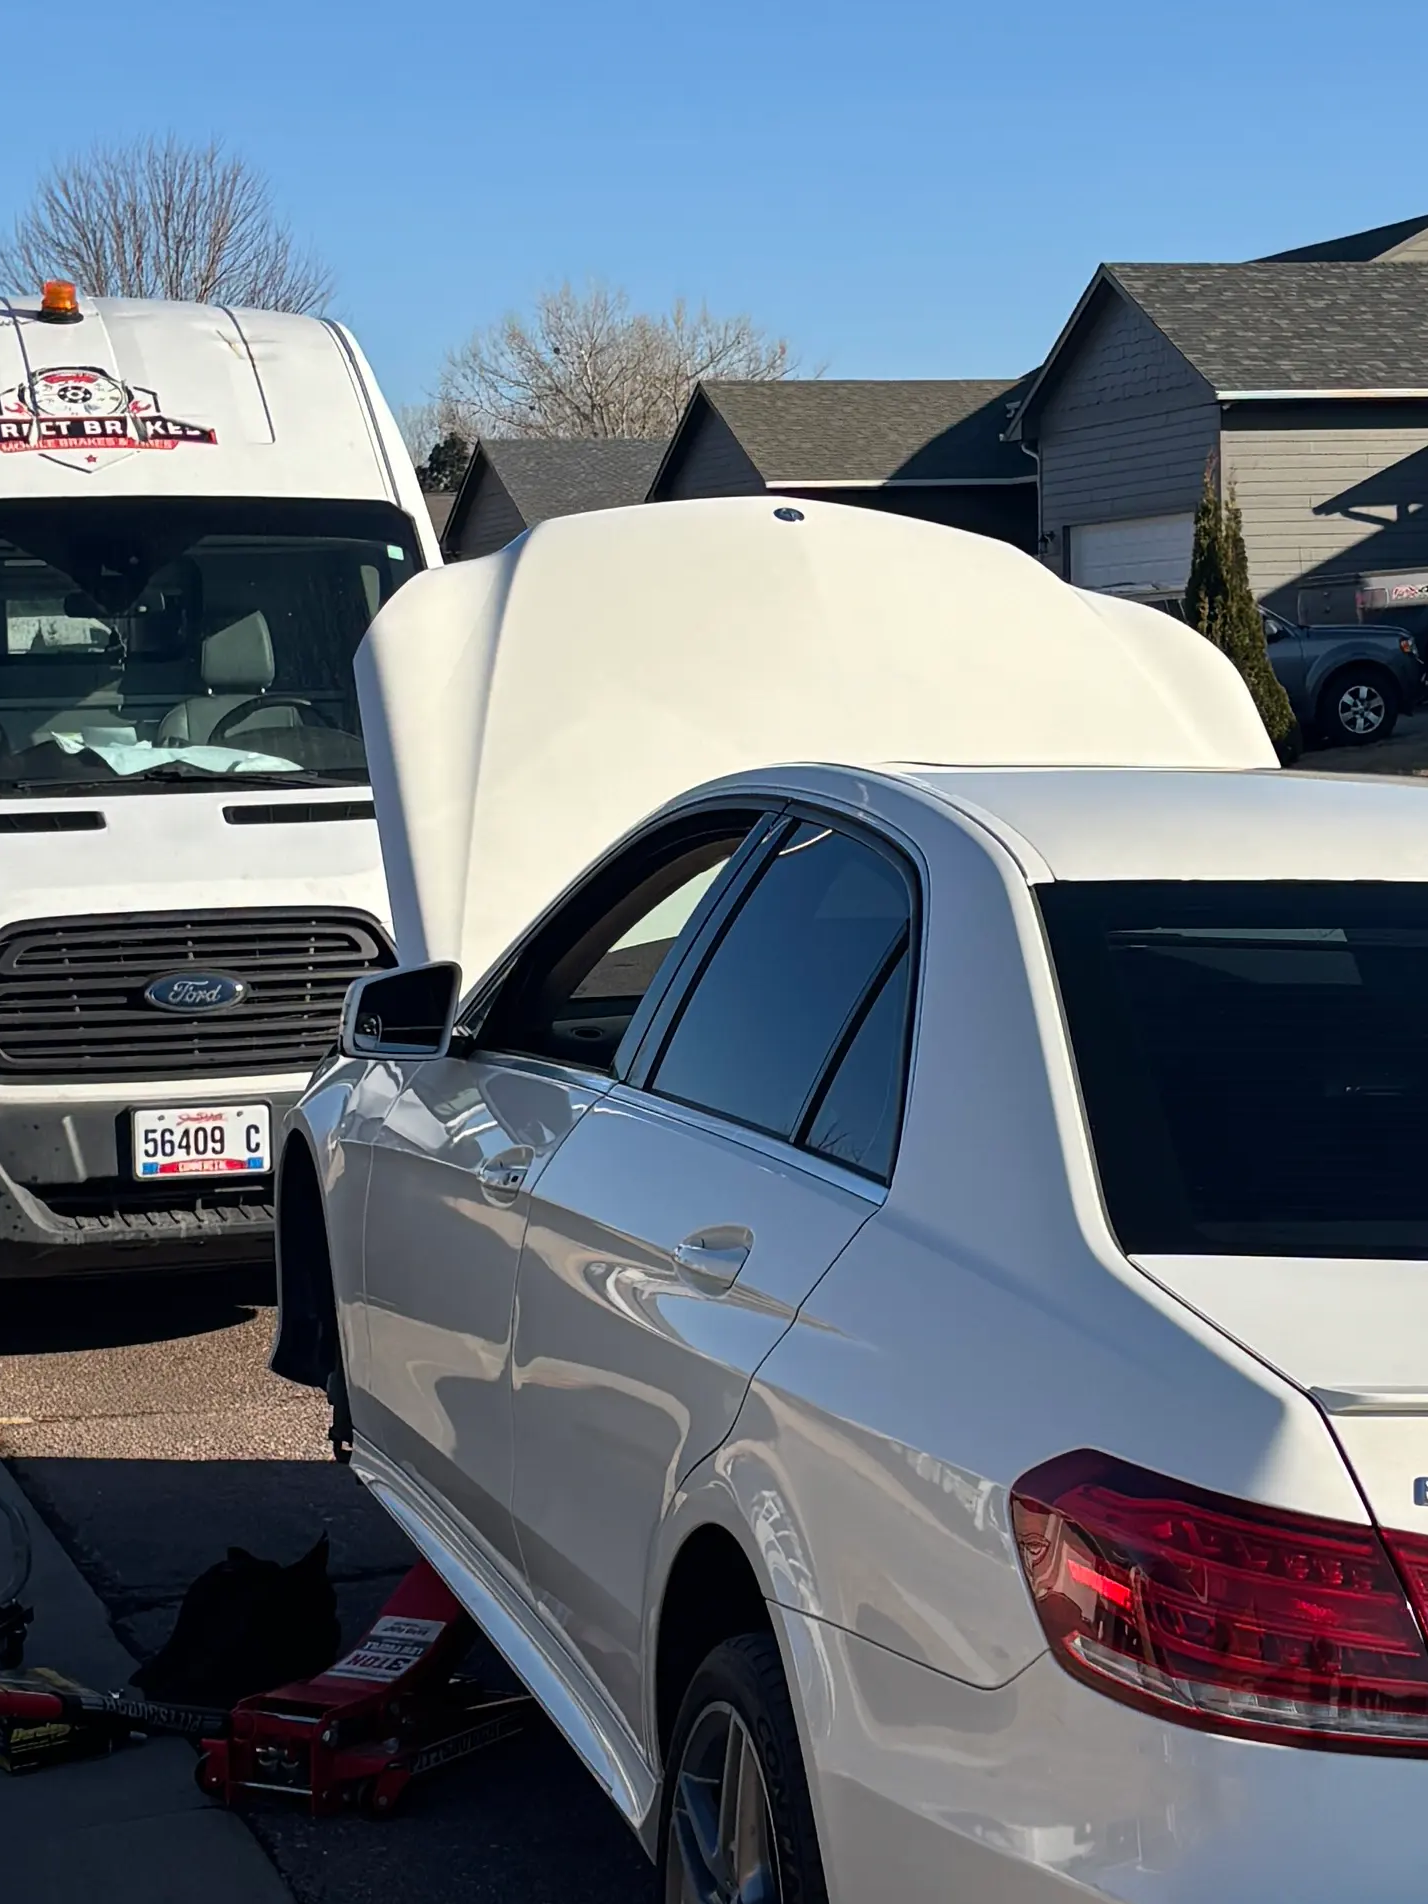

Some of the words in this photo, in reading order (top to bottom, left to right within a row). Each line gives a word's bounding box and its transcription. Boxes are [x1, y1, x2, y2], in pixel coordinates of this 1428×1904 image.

[168, 980, 222, 1004] Ford
[143, 1125, 225, 1158] 56409
[245, 1124, 261, 1154] C
